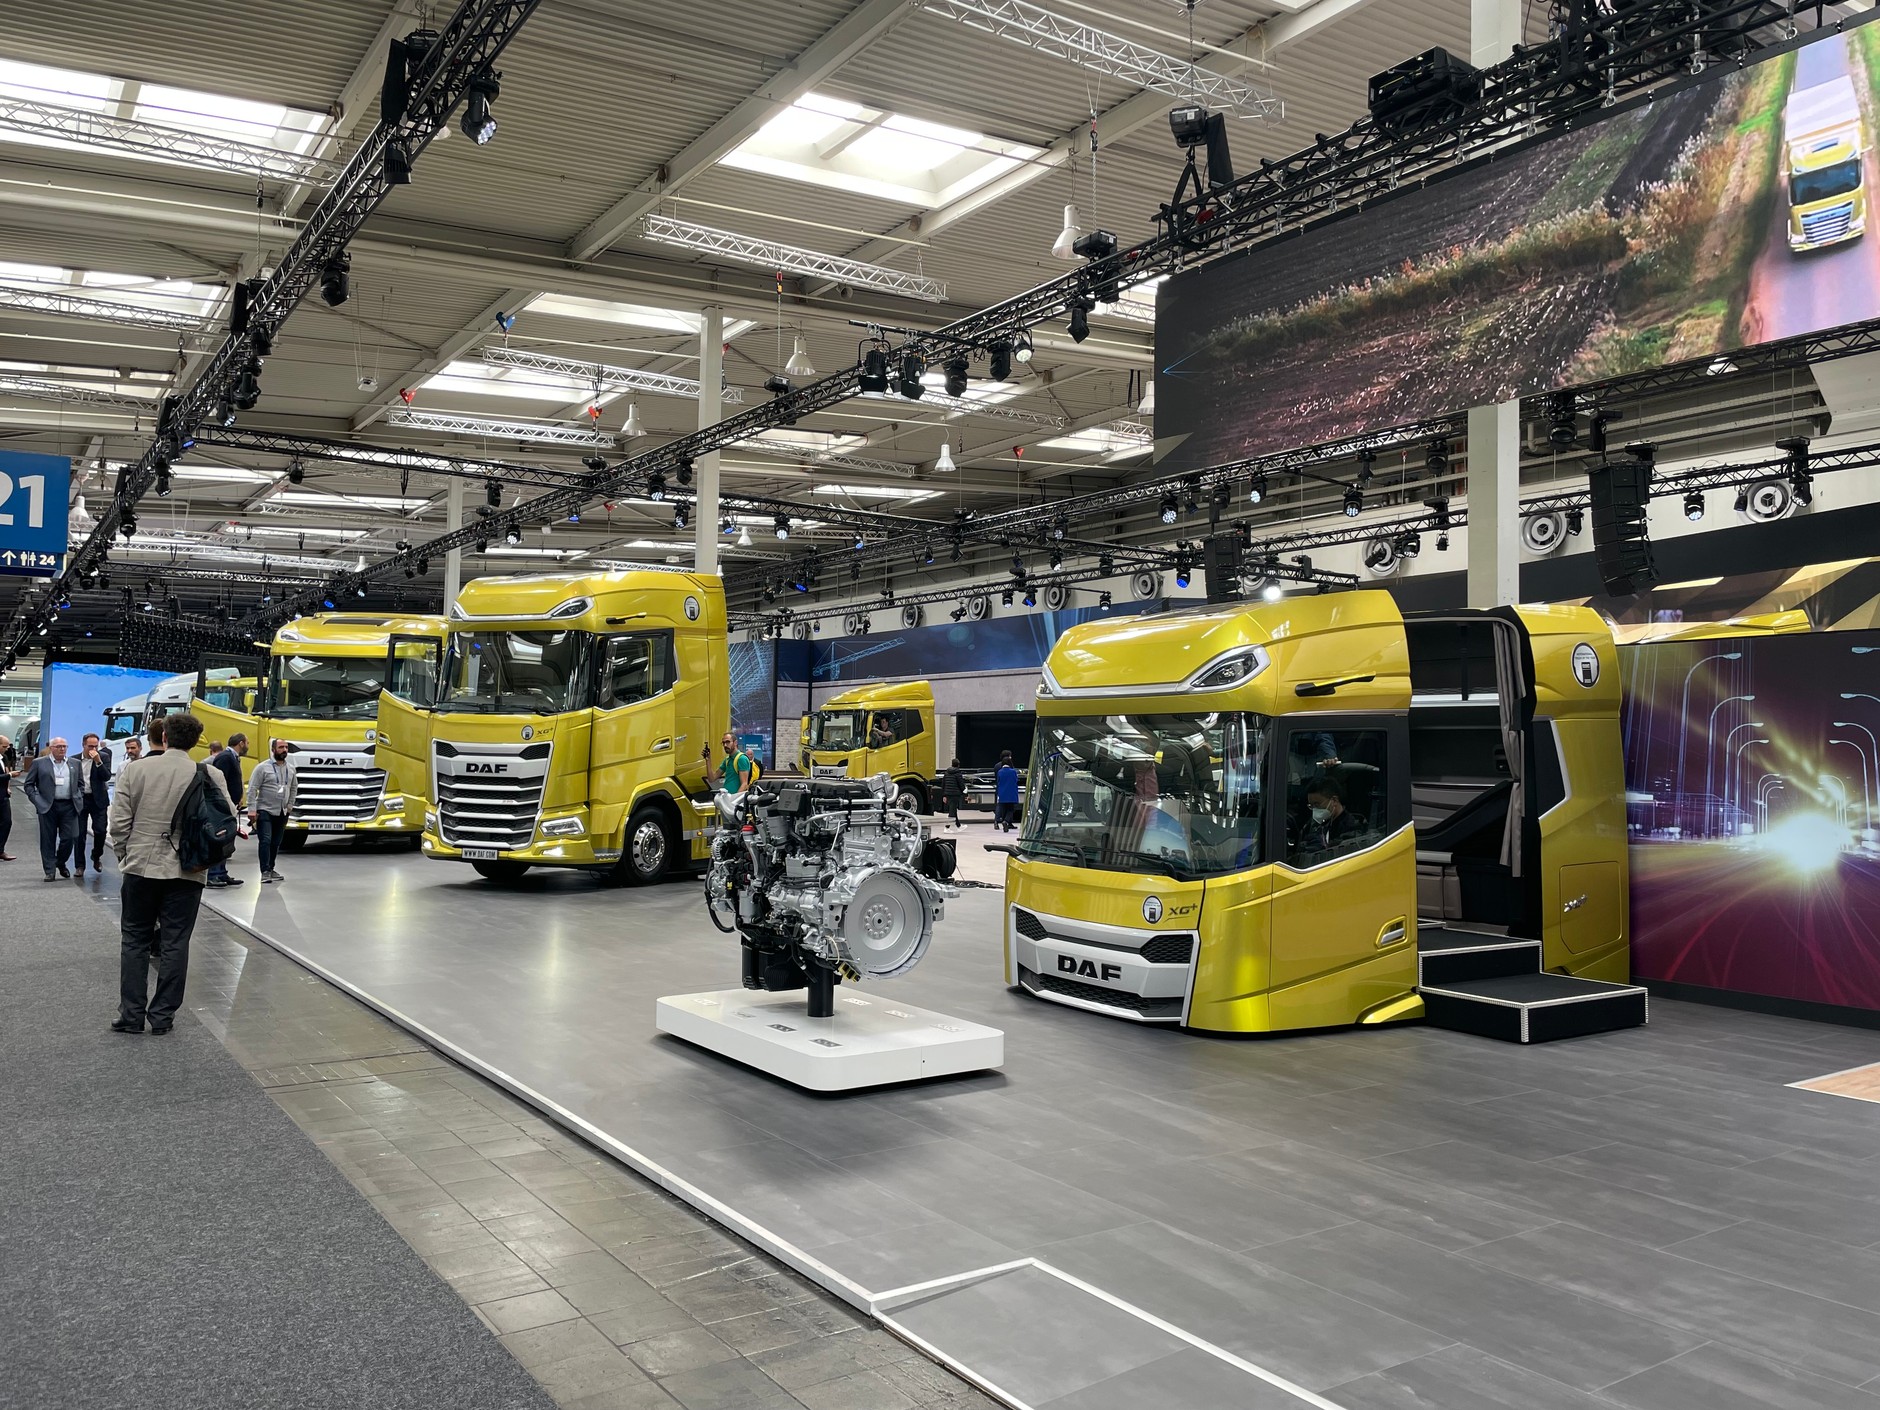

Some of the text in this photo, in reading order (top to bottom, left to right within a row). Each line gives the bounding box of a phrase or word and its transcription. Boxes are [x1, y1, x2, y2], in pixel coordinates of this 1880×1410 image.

[39, 554, 56, 566] 24
[309, 757, 353, 766] DAF
[465, 762, 508, 774] DAF
[1167, 903, 1198, 916] XG+
[1057, 954, 1122, 982] DAF
